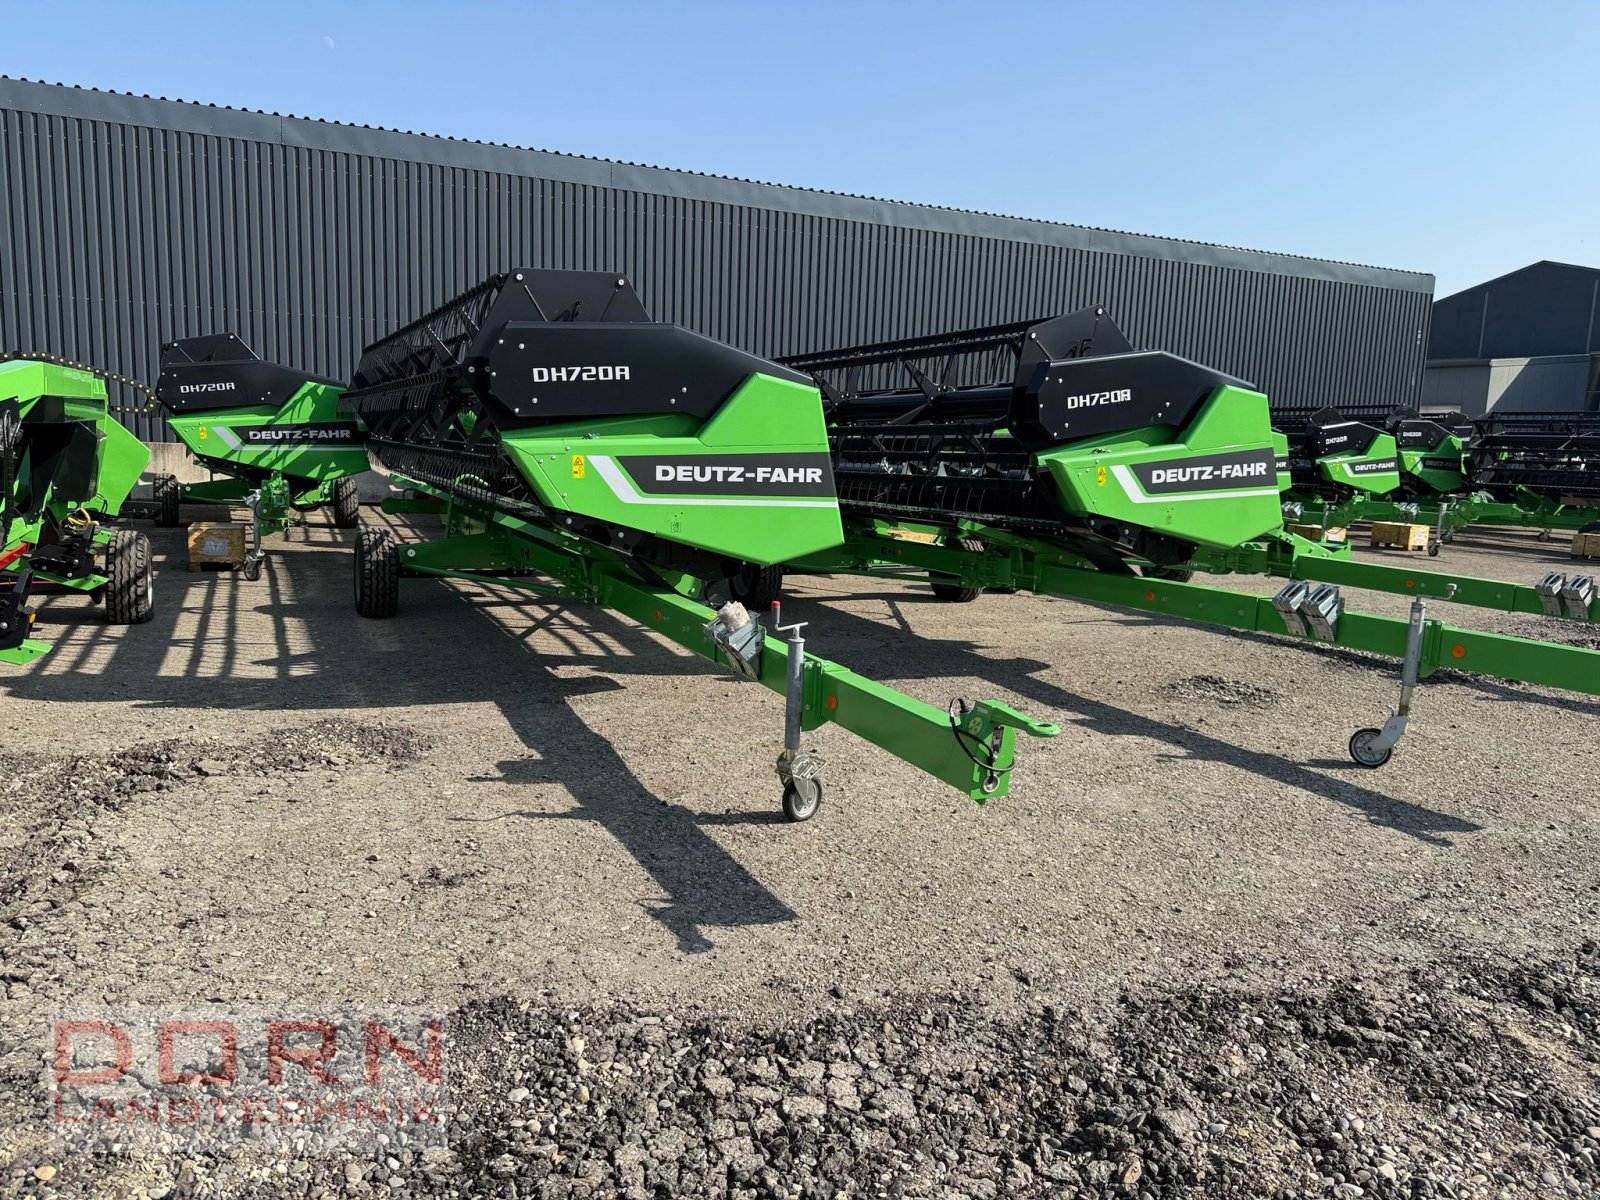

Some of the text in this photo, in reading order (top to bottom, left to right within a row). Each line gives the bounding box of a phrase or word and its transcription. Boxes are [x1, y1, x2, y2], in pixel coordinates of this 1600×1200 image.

[532, 366, 630, 383] DH720A
[180, 382, 236, 394] DH720A
[248, 429, 351, 440] DEUTZ-FAHR
[1151, 462, 1267, 484] DEUTZ-FAHR
[1354, 461, 1395, 471] DEUTZ-FAHR
[655, 465, 823, 483] DEUTZ-FAHR
